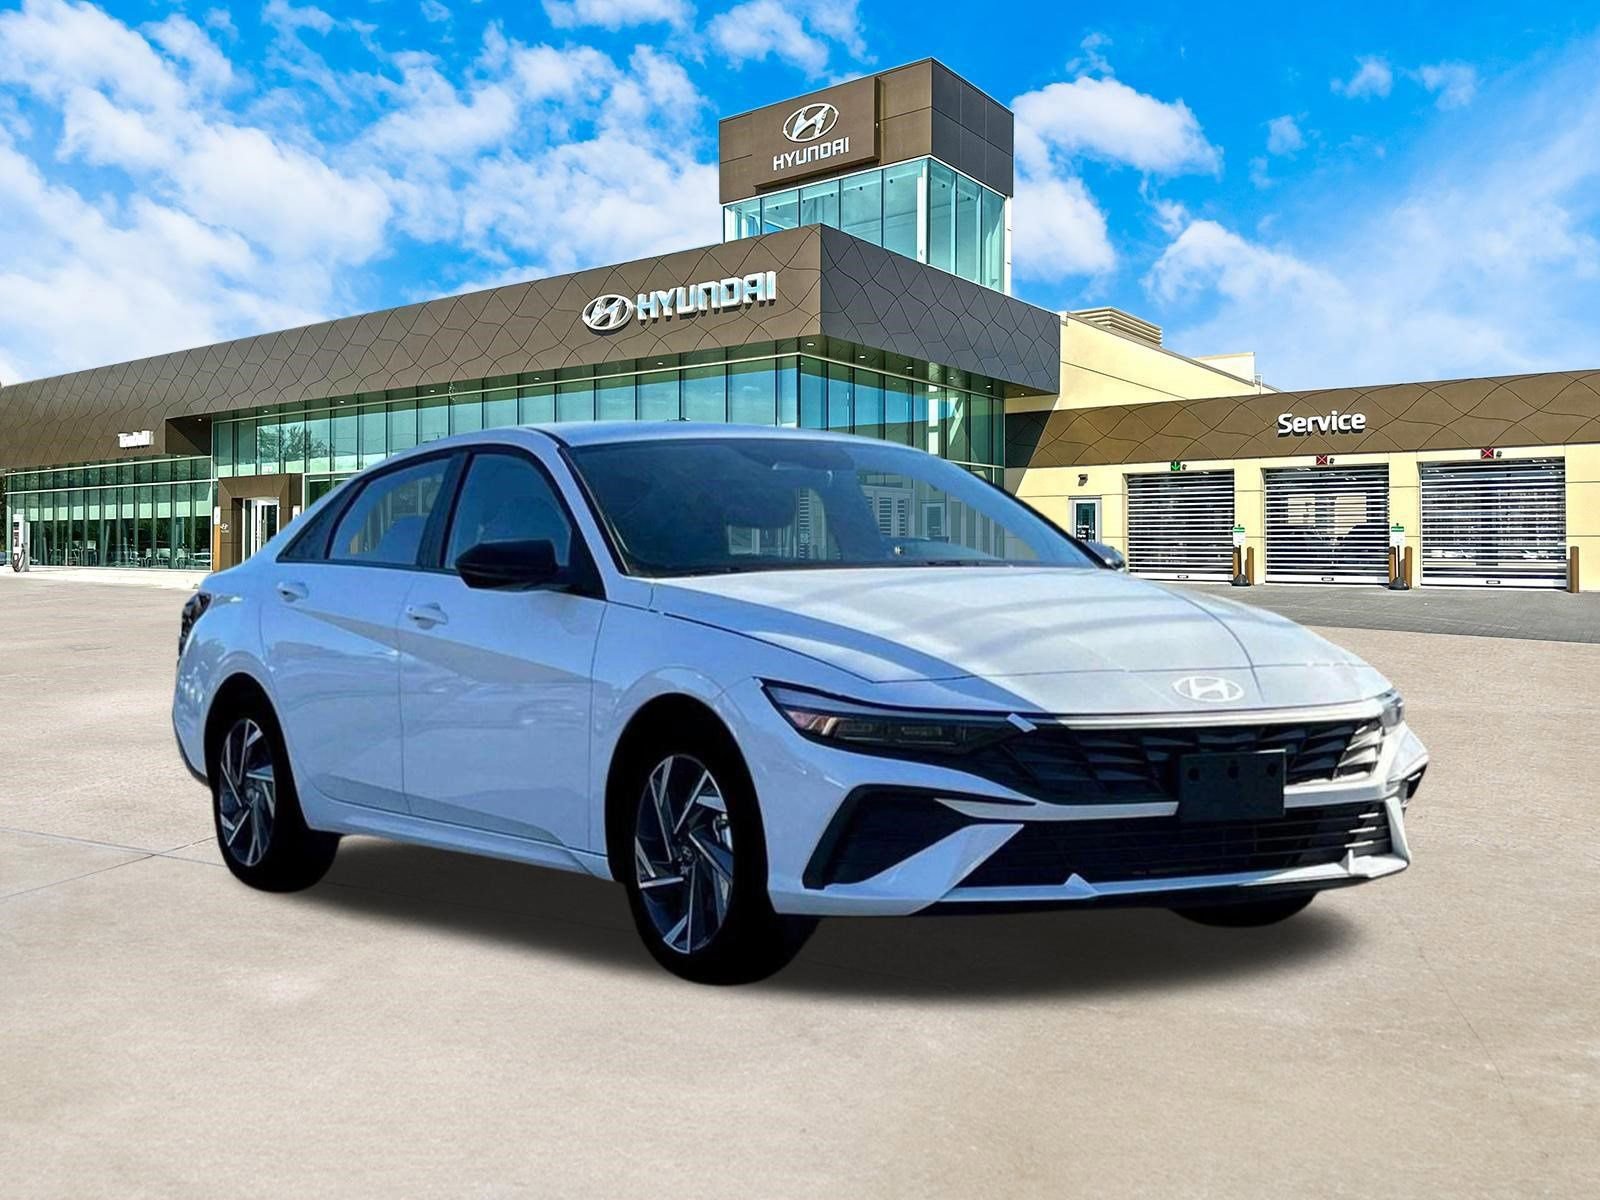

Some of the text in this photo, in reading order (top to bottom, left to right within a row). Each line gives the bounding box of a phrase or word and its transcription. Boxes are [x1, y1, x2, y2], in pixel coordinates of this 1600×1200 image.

[773, 136, 849, 171] HYUNDAI
[637, 270, 777, 321] HYUNDAI
[1277, 410, 1367, 434] Service
